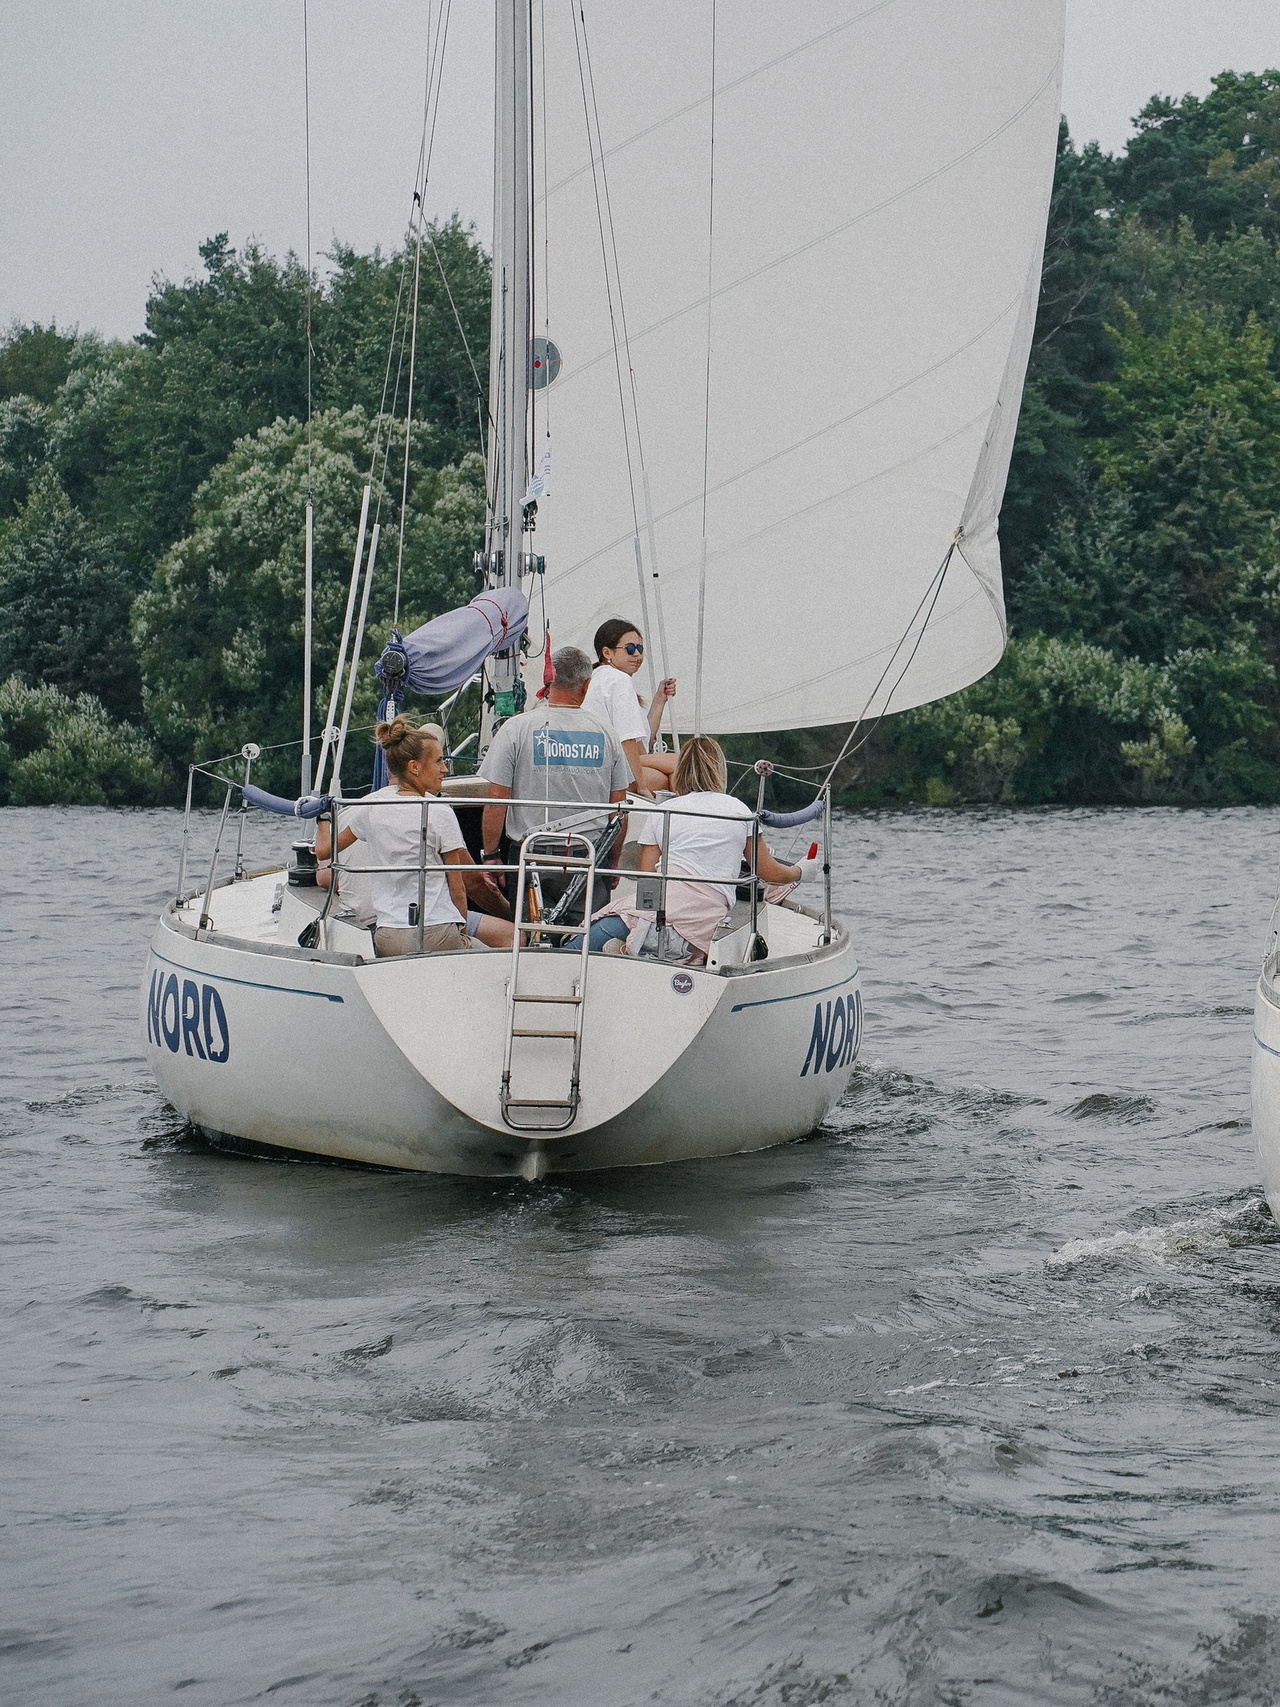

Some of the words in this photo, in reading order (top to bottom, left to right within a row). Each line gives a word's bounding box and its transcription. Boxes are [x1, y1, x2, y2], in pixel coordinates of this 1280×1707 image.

[543, 742, 600, 760] NORDSTAR
[148, 968, 230, 1063] NORD
[800, 989, 863, 1077] NORD
